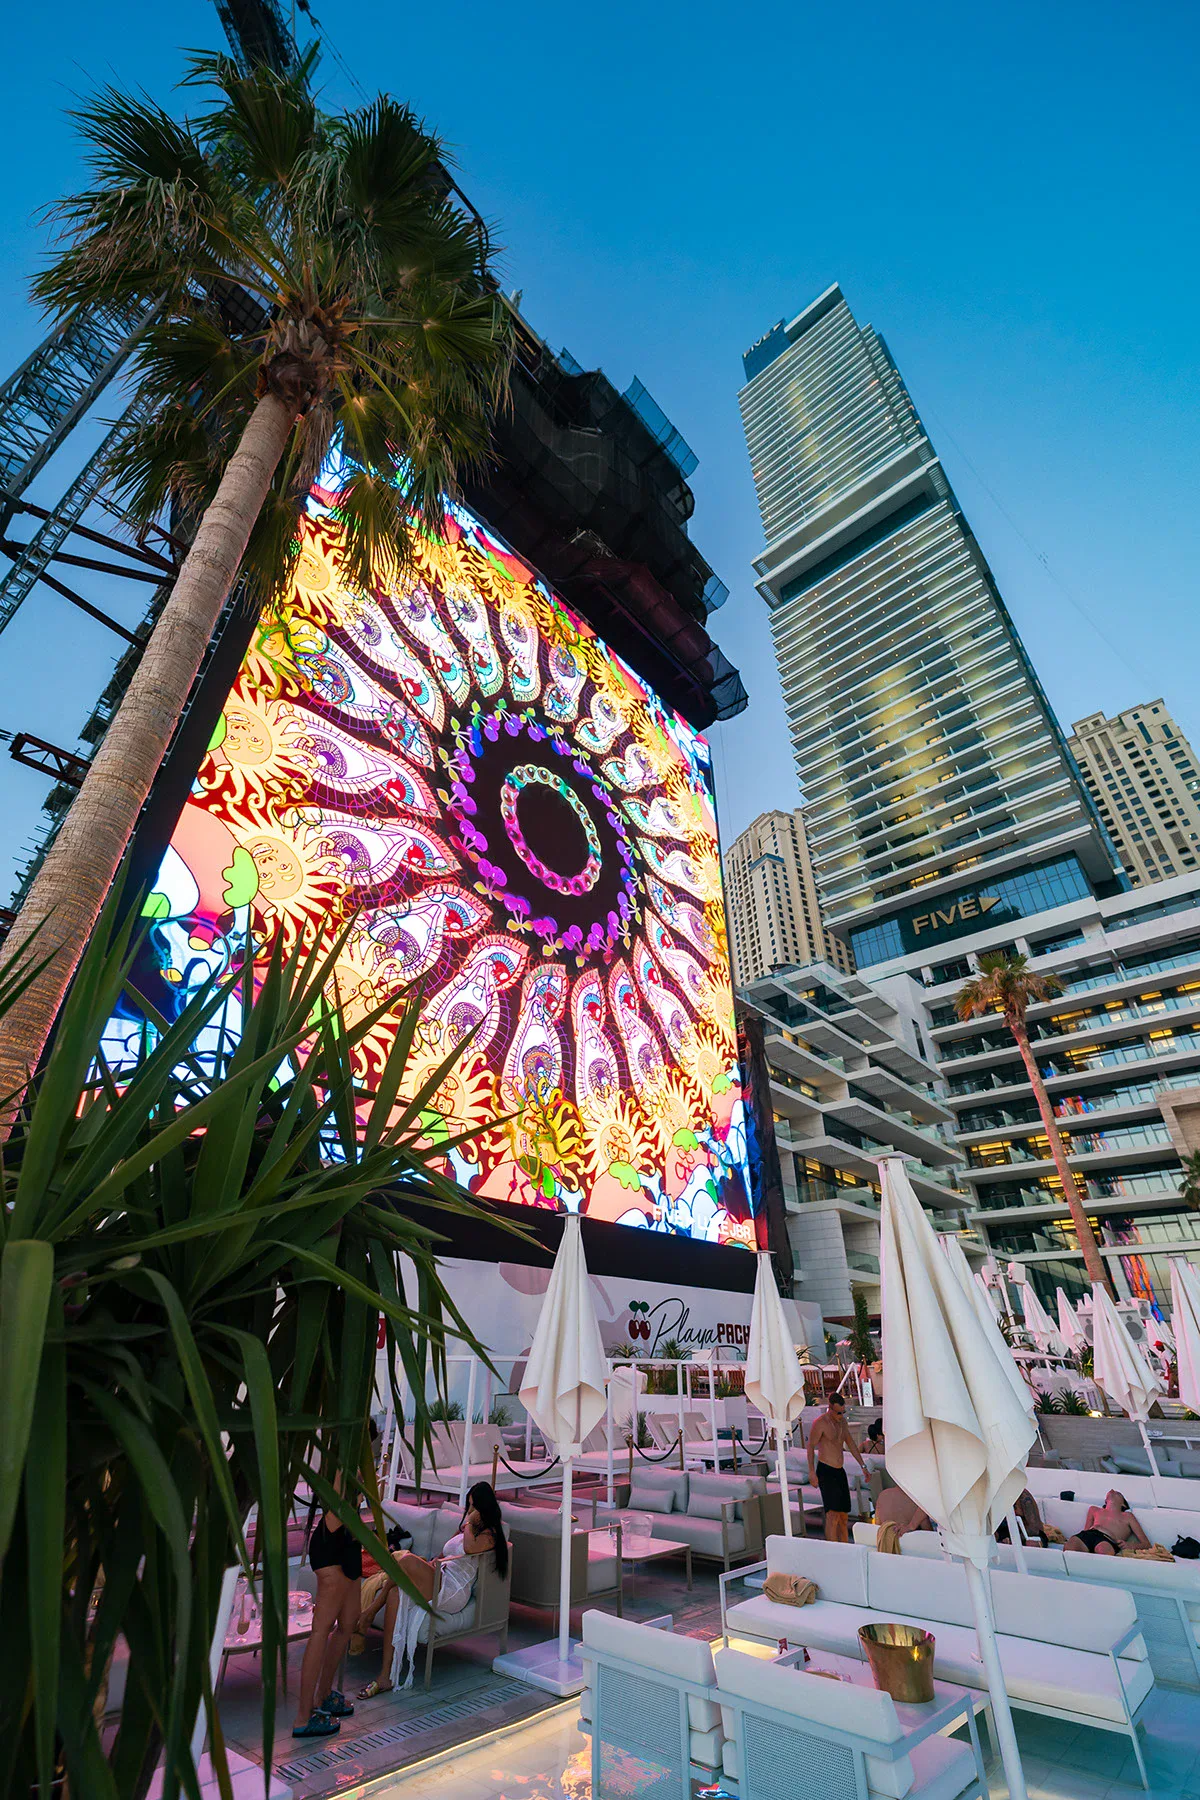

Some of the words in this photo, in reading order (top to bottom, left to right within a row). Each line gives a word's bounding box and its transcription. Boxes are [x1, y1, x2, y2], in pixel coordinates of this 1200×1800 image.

[912, 899, 980, 936] FIVE
[729, 1222, 752, 1239] JBR
[648, 1297, 718, 1358] Playa
[716, 1323, 750, 1345] PACH
